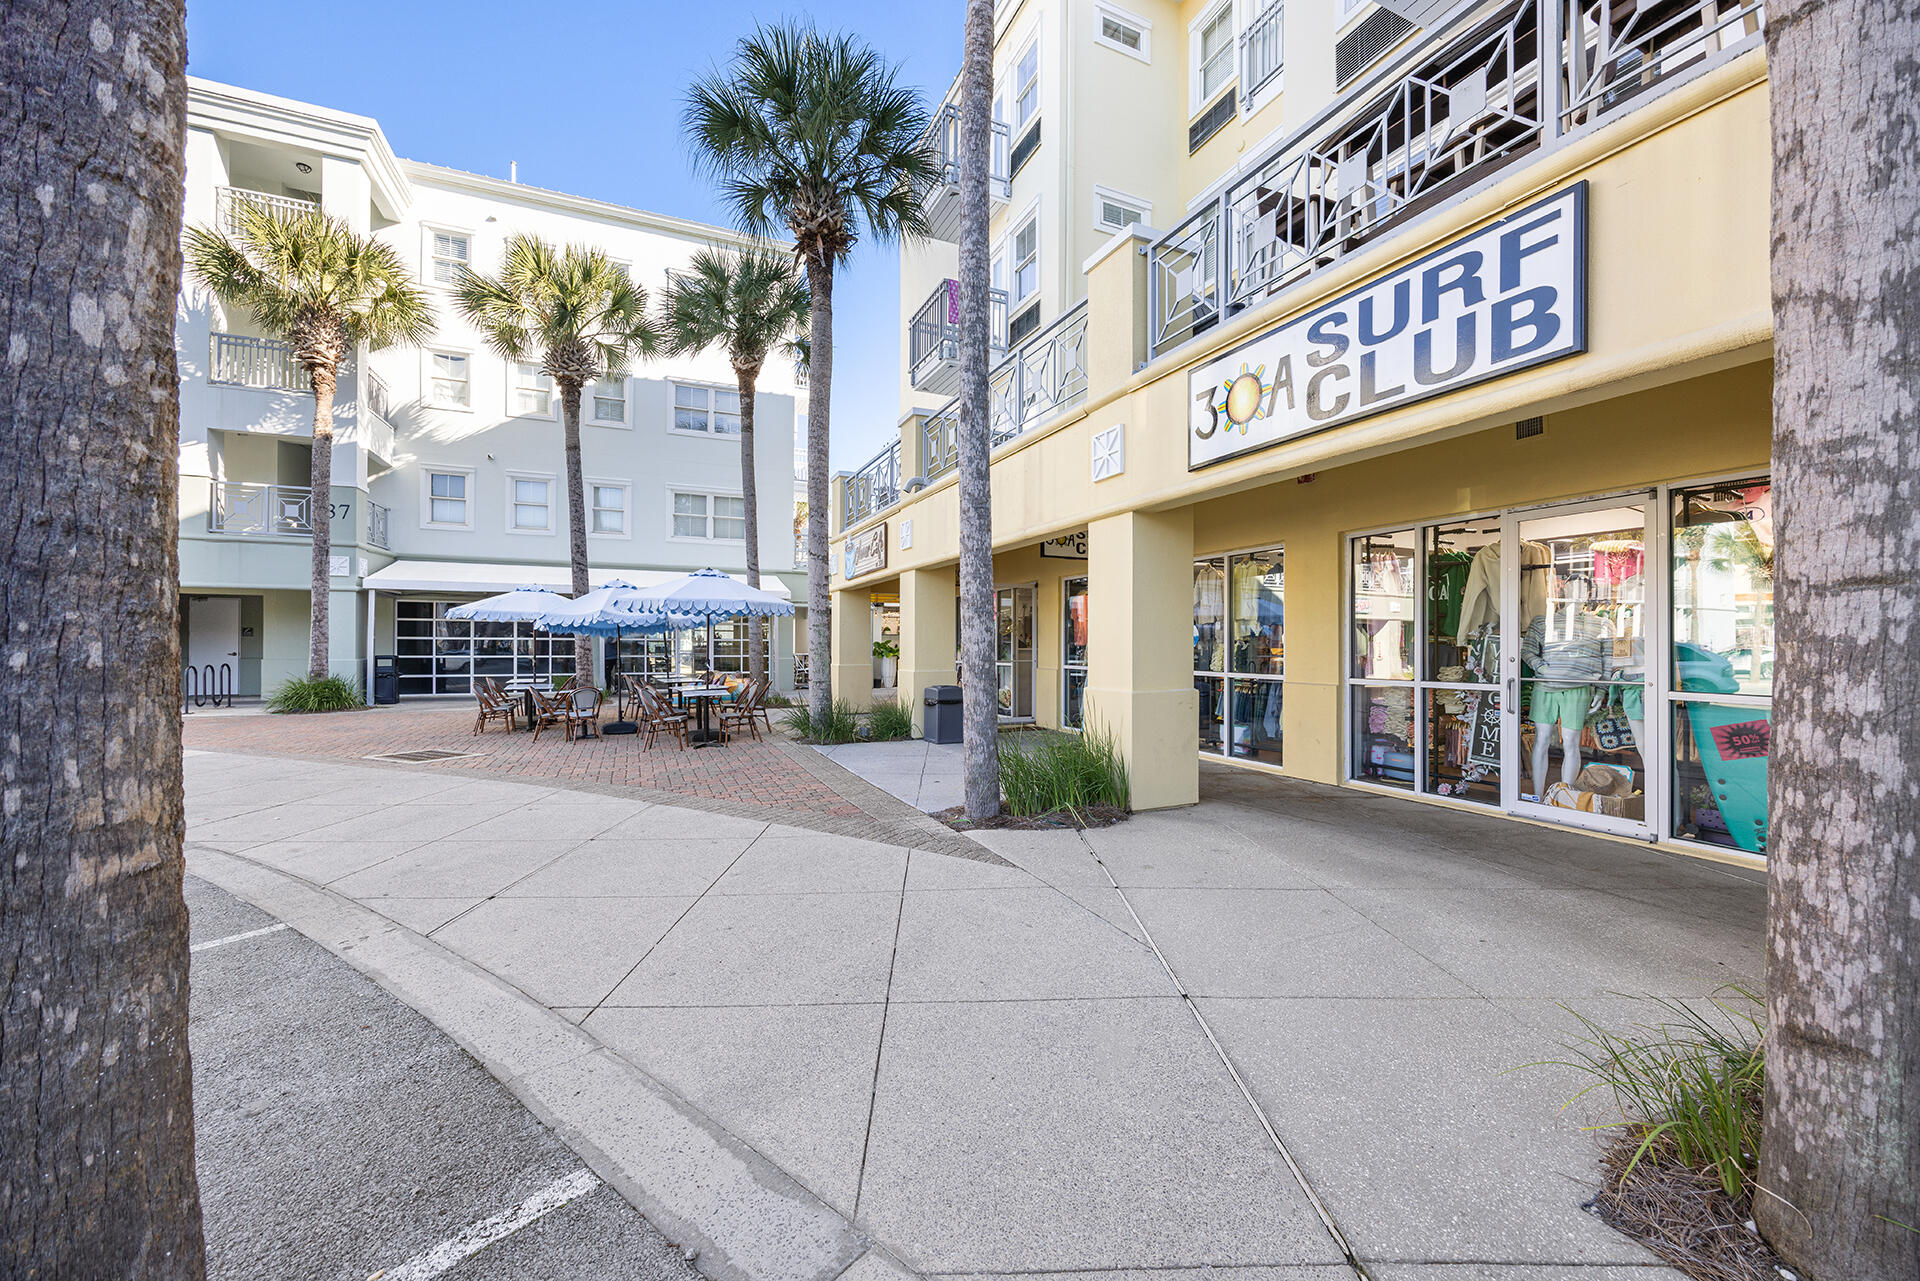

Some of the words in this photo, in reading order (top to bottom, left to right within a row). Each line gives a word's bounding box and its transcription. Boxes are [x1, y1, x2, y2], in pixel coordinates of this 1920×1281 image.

[1195, 354, 1295, 440] 30A
[1306, 285, 1561, 421] CLUB
[1307, 208, 1562, 368] SURF
